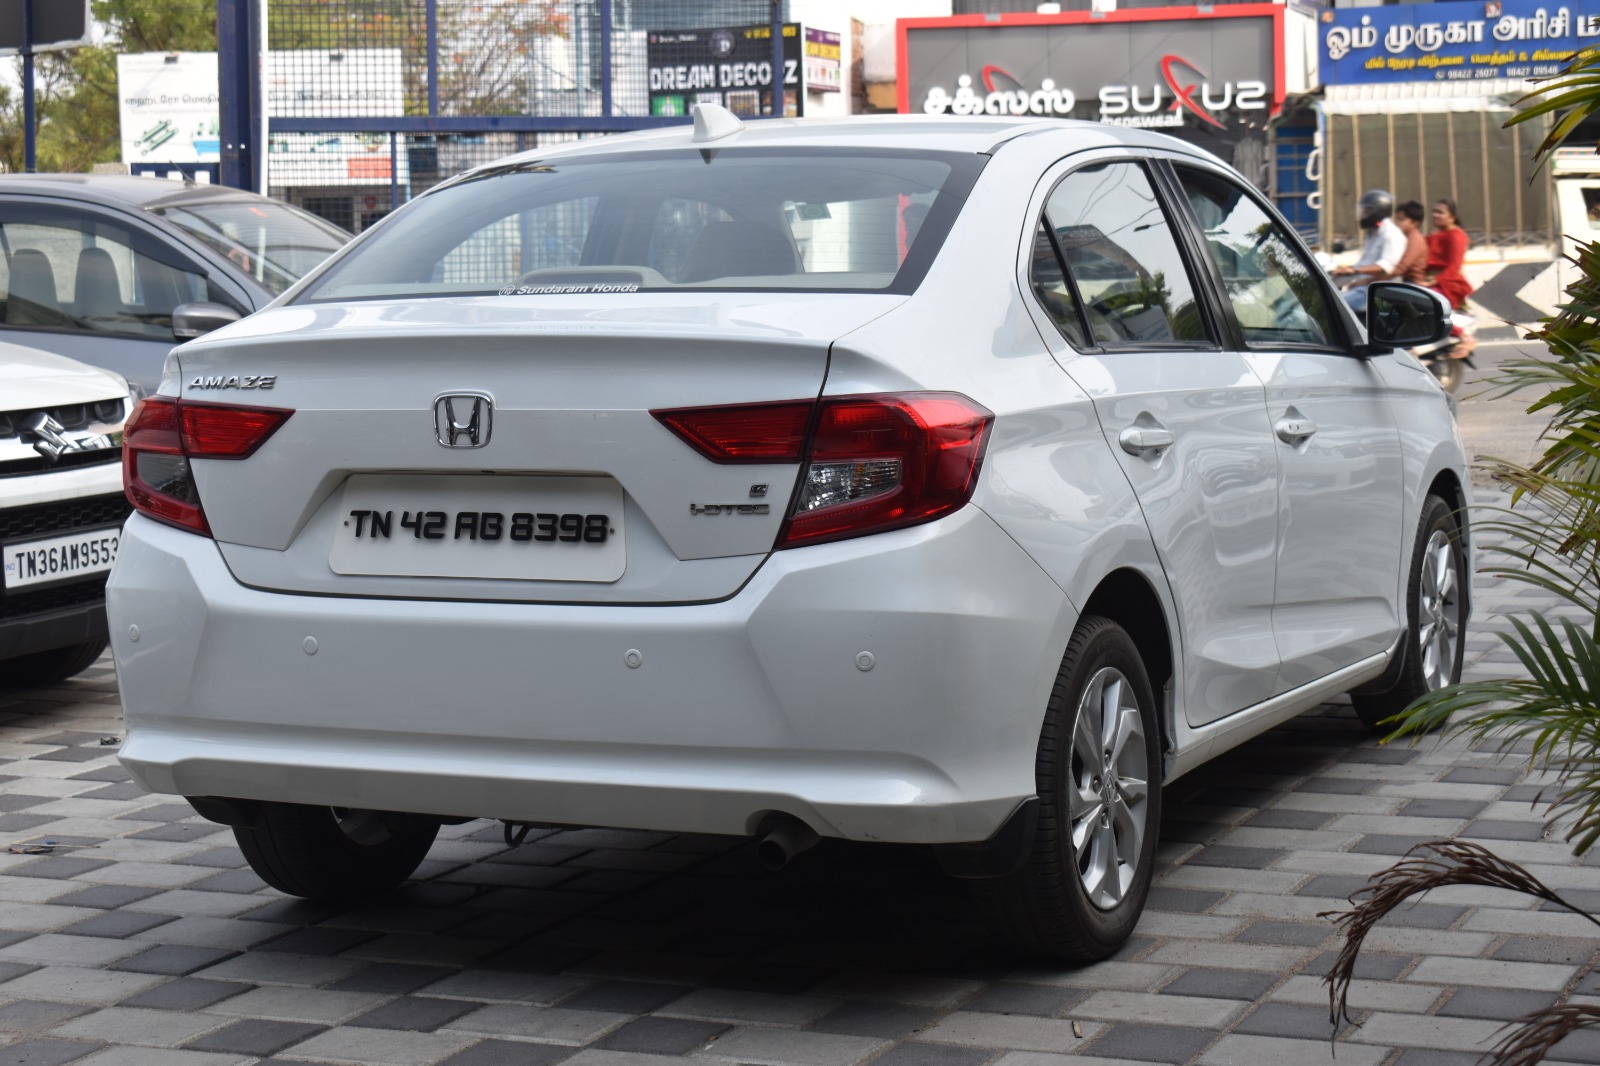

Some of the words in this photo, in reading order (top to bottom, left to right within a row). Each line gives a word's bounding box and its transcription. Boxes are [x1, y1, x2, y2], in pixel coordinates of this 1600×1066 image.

[1326, 16, 1377, 60] ஓம்
[1385, 20, 1485, 54] முருகா
[1493, 7, 1570, 41] அரிசி
[650, 64, 716, 91] DREAM
[516, 284, 589, 295] Sundaram
[591, 283, 639, 293] Honda
[188, 375, 277, 390] AMAZE
[350, 510, 393, 538] TN
[400, 511, 446, 539] 42
[454, 511, 503, 540] AB
[510, 512, 609, 543] 8398
[16, 536, 119, 579] TN36AM9553
